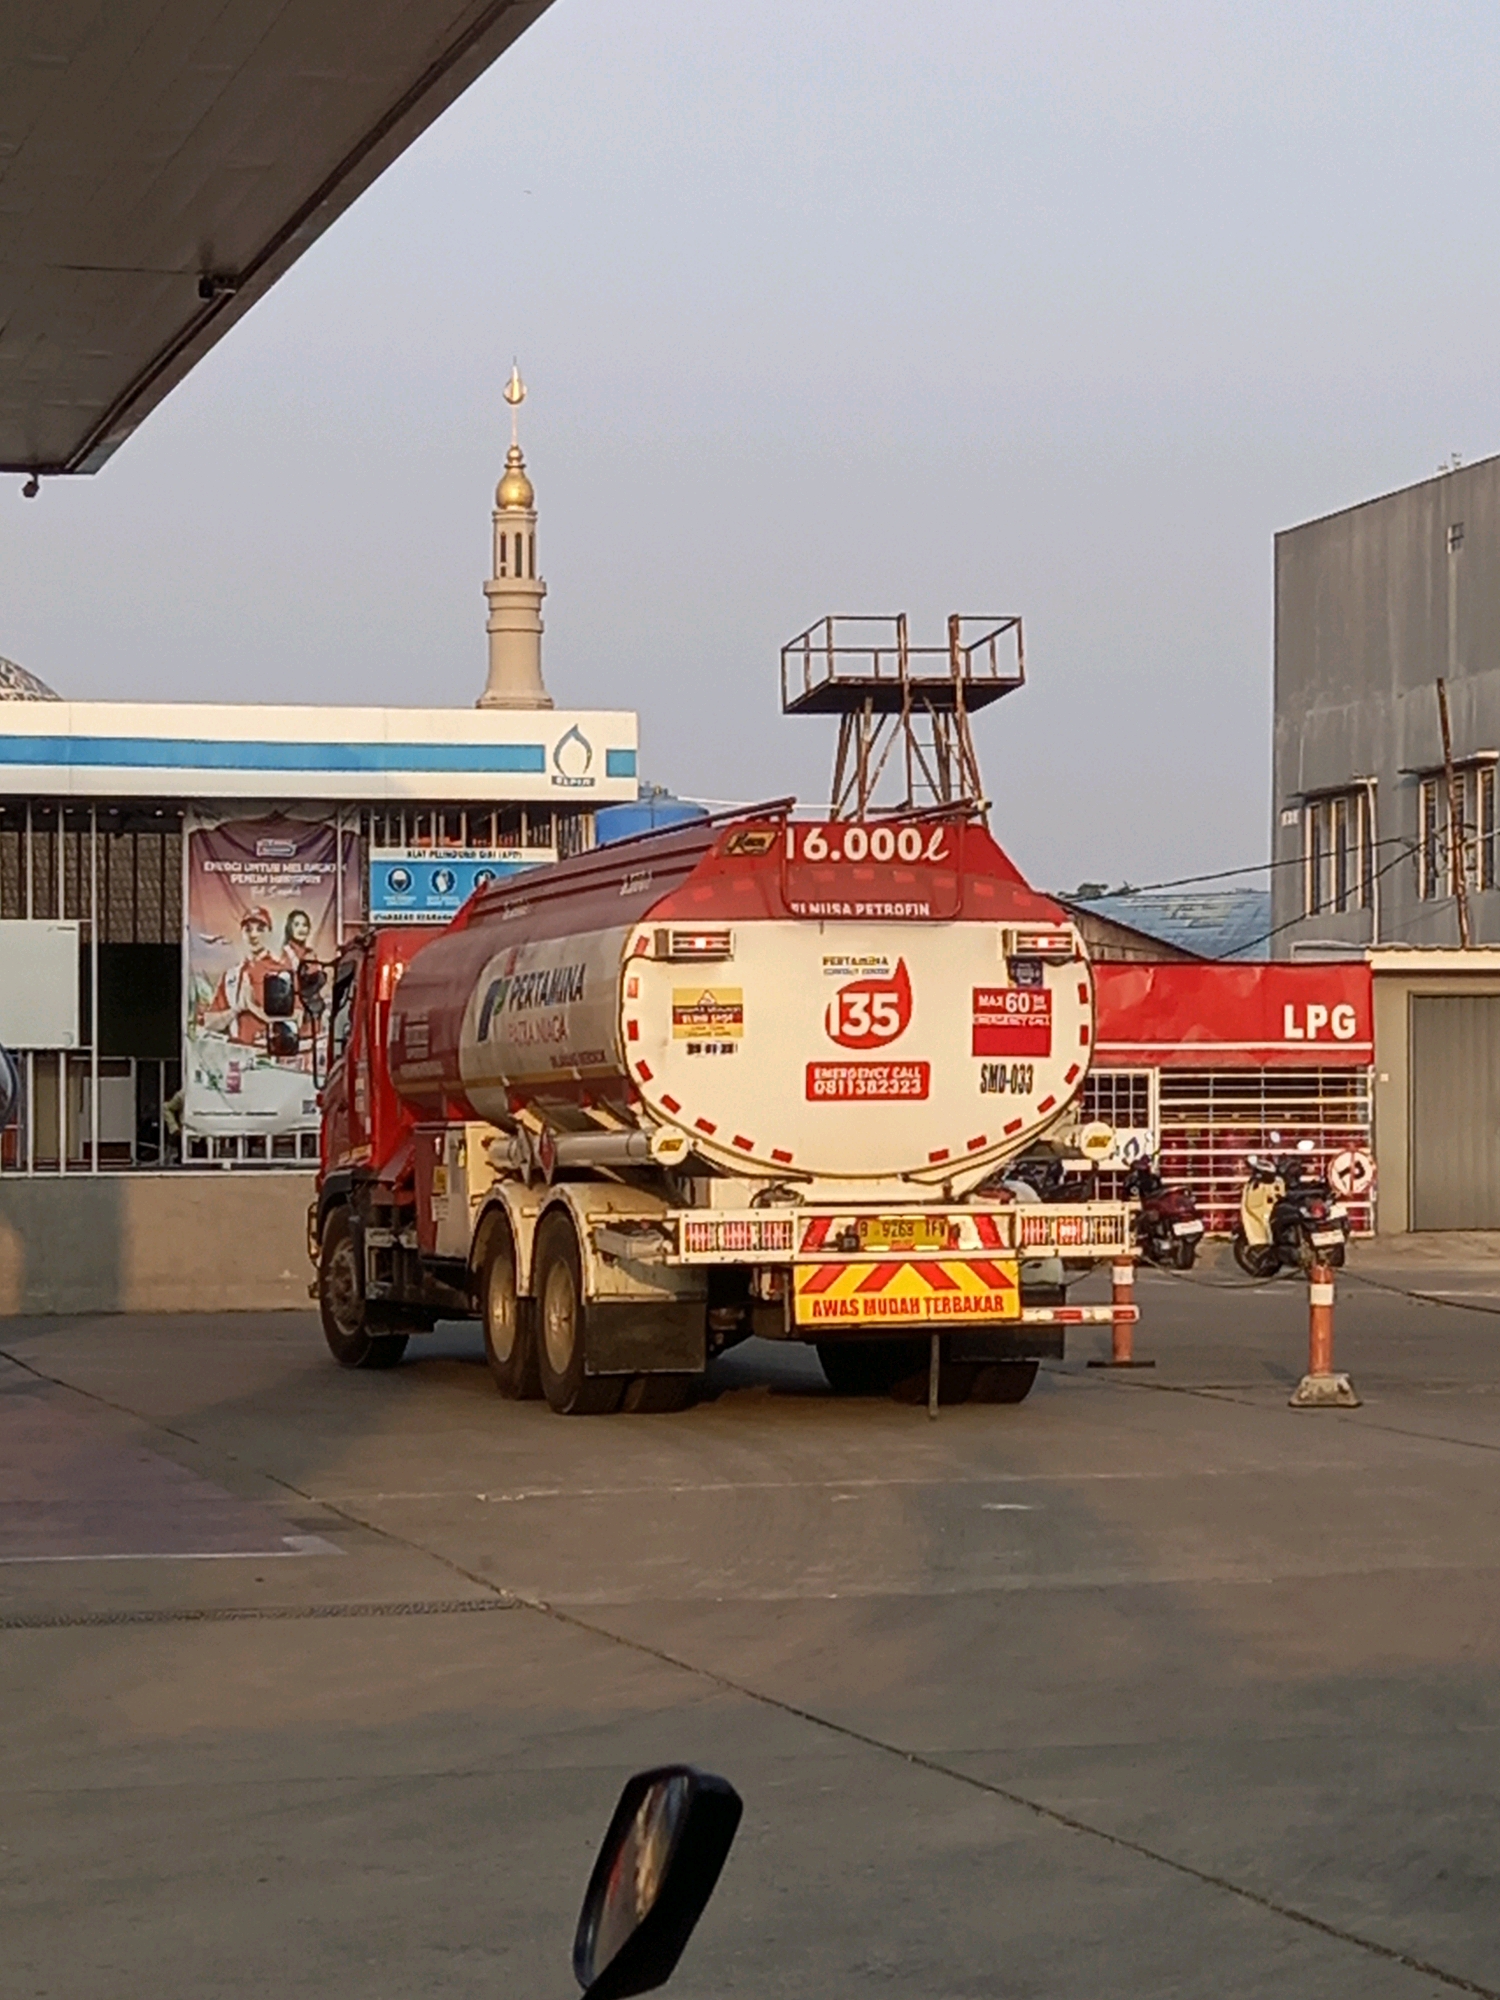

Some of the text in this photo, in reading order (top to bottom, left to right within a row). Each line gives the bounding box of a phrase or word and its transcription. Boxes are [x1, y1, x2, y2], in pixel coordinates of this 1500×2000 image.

[855, 902, 930, 915] PETROFIN
[823, 956, 889, 966] PERTAMINA
[509, 963, 586, 1013] PERTAMINA
[979, 994, 1003, 1007] MAX
[1005, 992, 1030, 1013] 60
[829, 992, 900, 1036] 135
[1284, 1004, 1356, 1040] LPG
[814, 1067, 921, 1080] EMERGENCY CALL
[980, 1063, 1034, 1094] SMD-033
[860, 1220, 869, 1238] B
[813, 1295, 1004, 1317] AWAS MUDAH TERBAKAR
